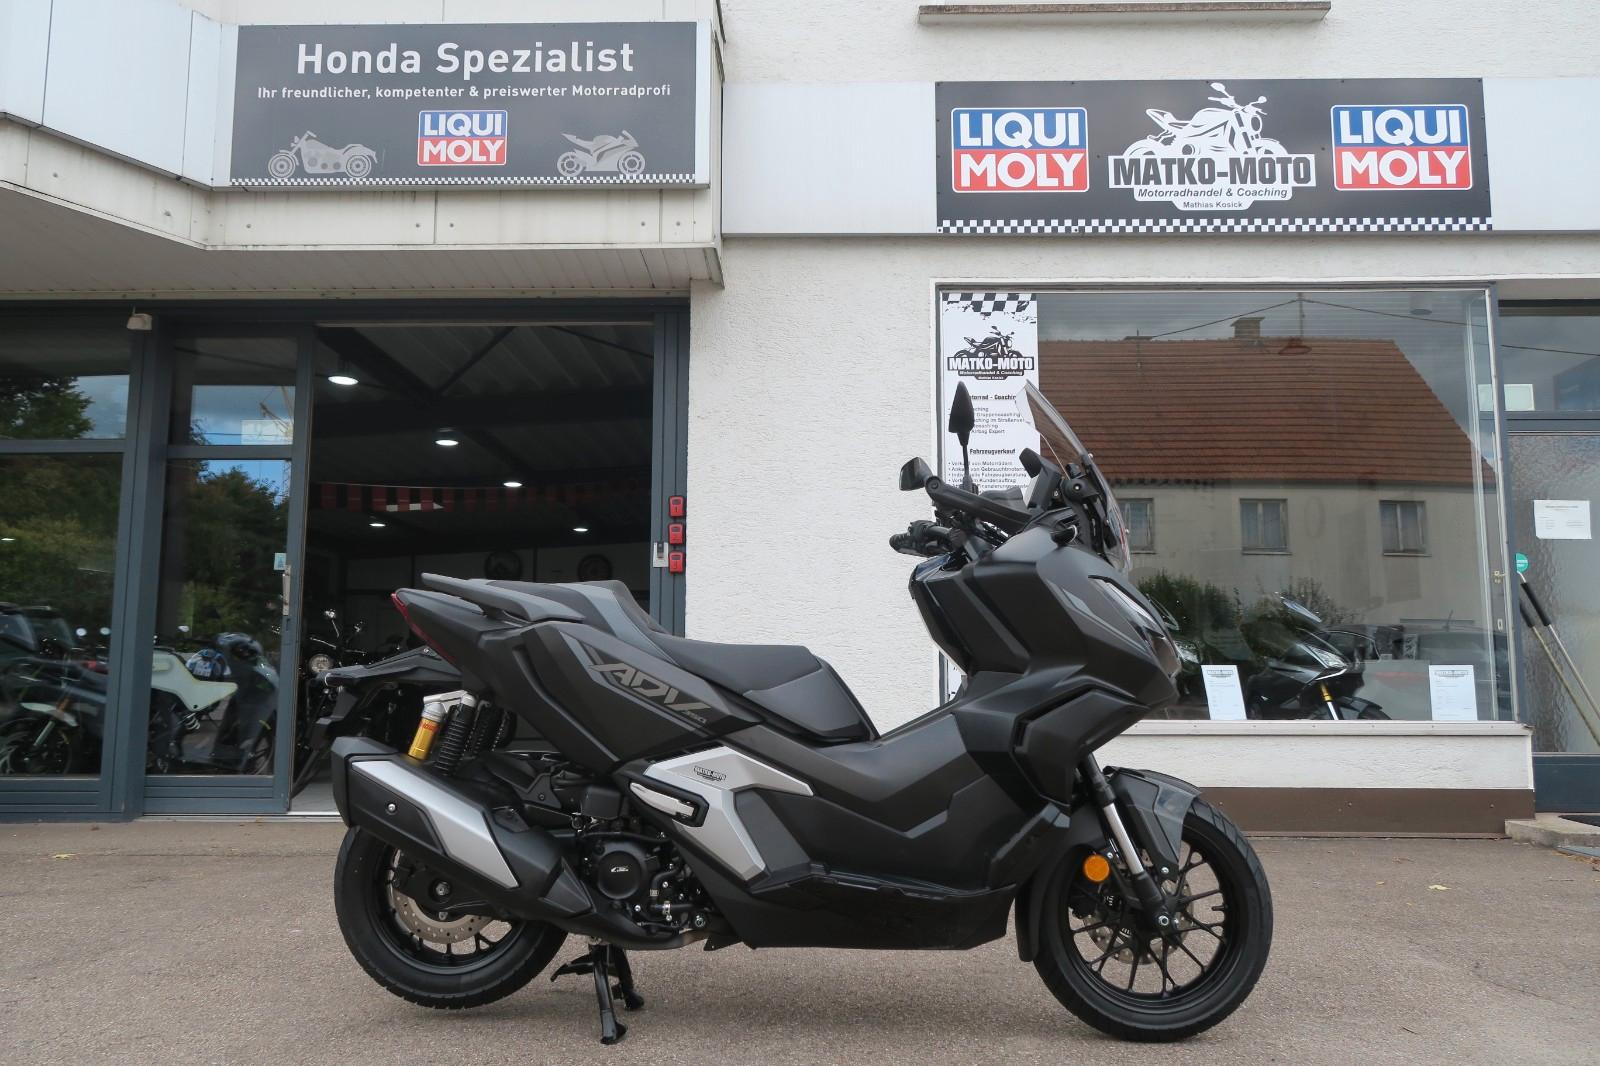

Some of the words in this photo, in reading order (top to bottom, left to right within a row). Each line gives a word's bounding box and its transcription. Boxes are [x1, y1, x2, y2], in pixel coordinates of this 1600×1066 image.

[297, 43, 422, 74] Honda
[436, 41, 634, 80] Spezialist
[258, 87, 278, 98] Ihr
[281, 86, 371, 100] freundlicher,
[376, 86, 464, 100] kompetenter
[469, 86, 480, 97] &
[483, 86, 568, 100] preiswerter
[572, 84, 672, 99] Motorradprofi
[424, 112, 503, 137] LIQUI
[960, 112, 1079, 148] LIQUI
[1338, 109, 1462, 145] LIQUI
[422, 140, 505, 163] MOLY
[1340, 150, 1468, 186] MOLY
[960, 152, 1085, 188] MOLY
[1113, 156, 1311, 186] MATKO-MOTO
[1138, 188, 1222, 198] Motorradhandel
[1226, 188, 1233, 197] &
[1237, 188, 1288, 198] Coaching
[950, 358, 1032, 370] MATKO-MOTO
[588, 662, 711, 712] ADV
